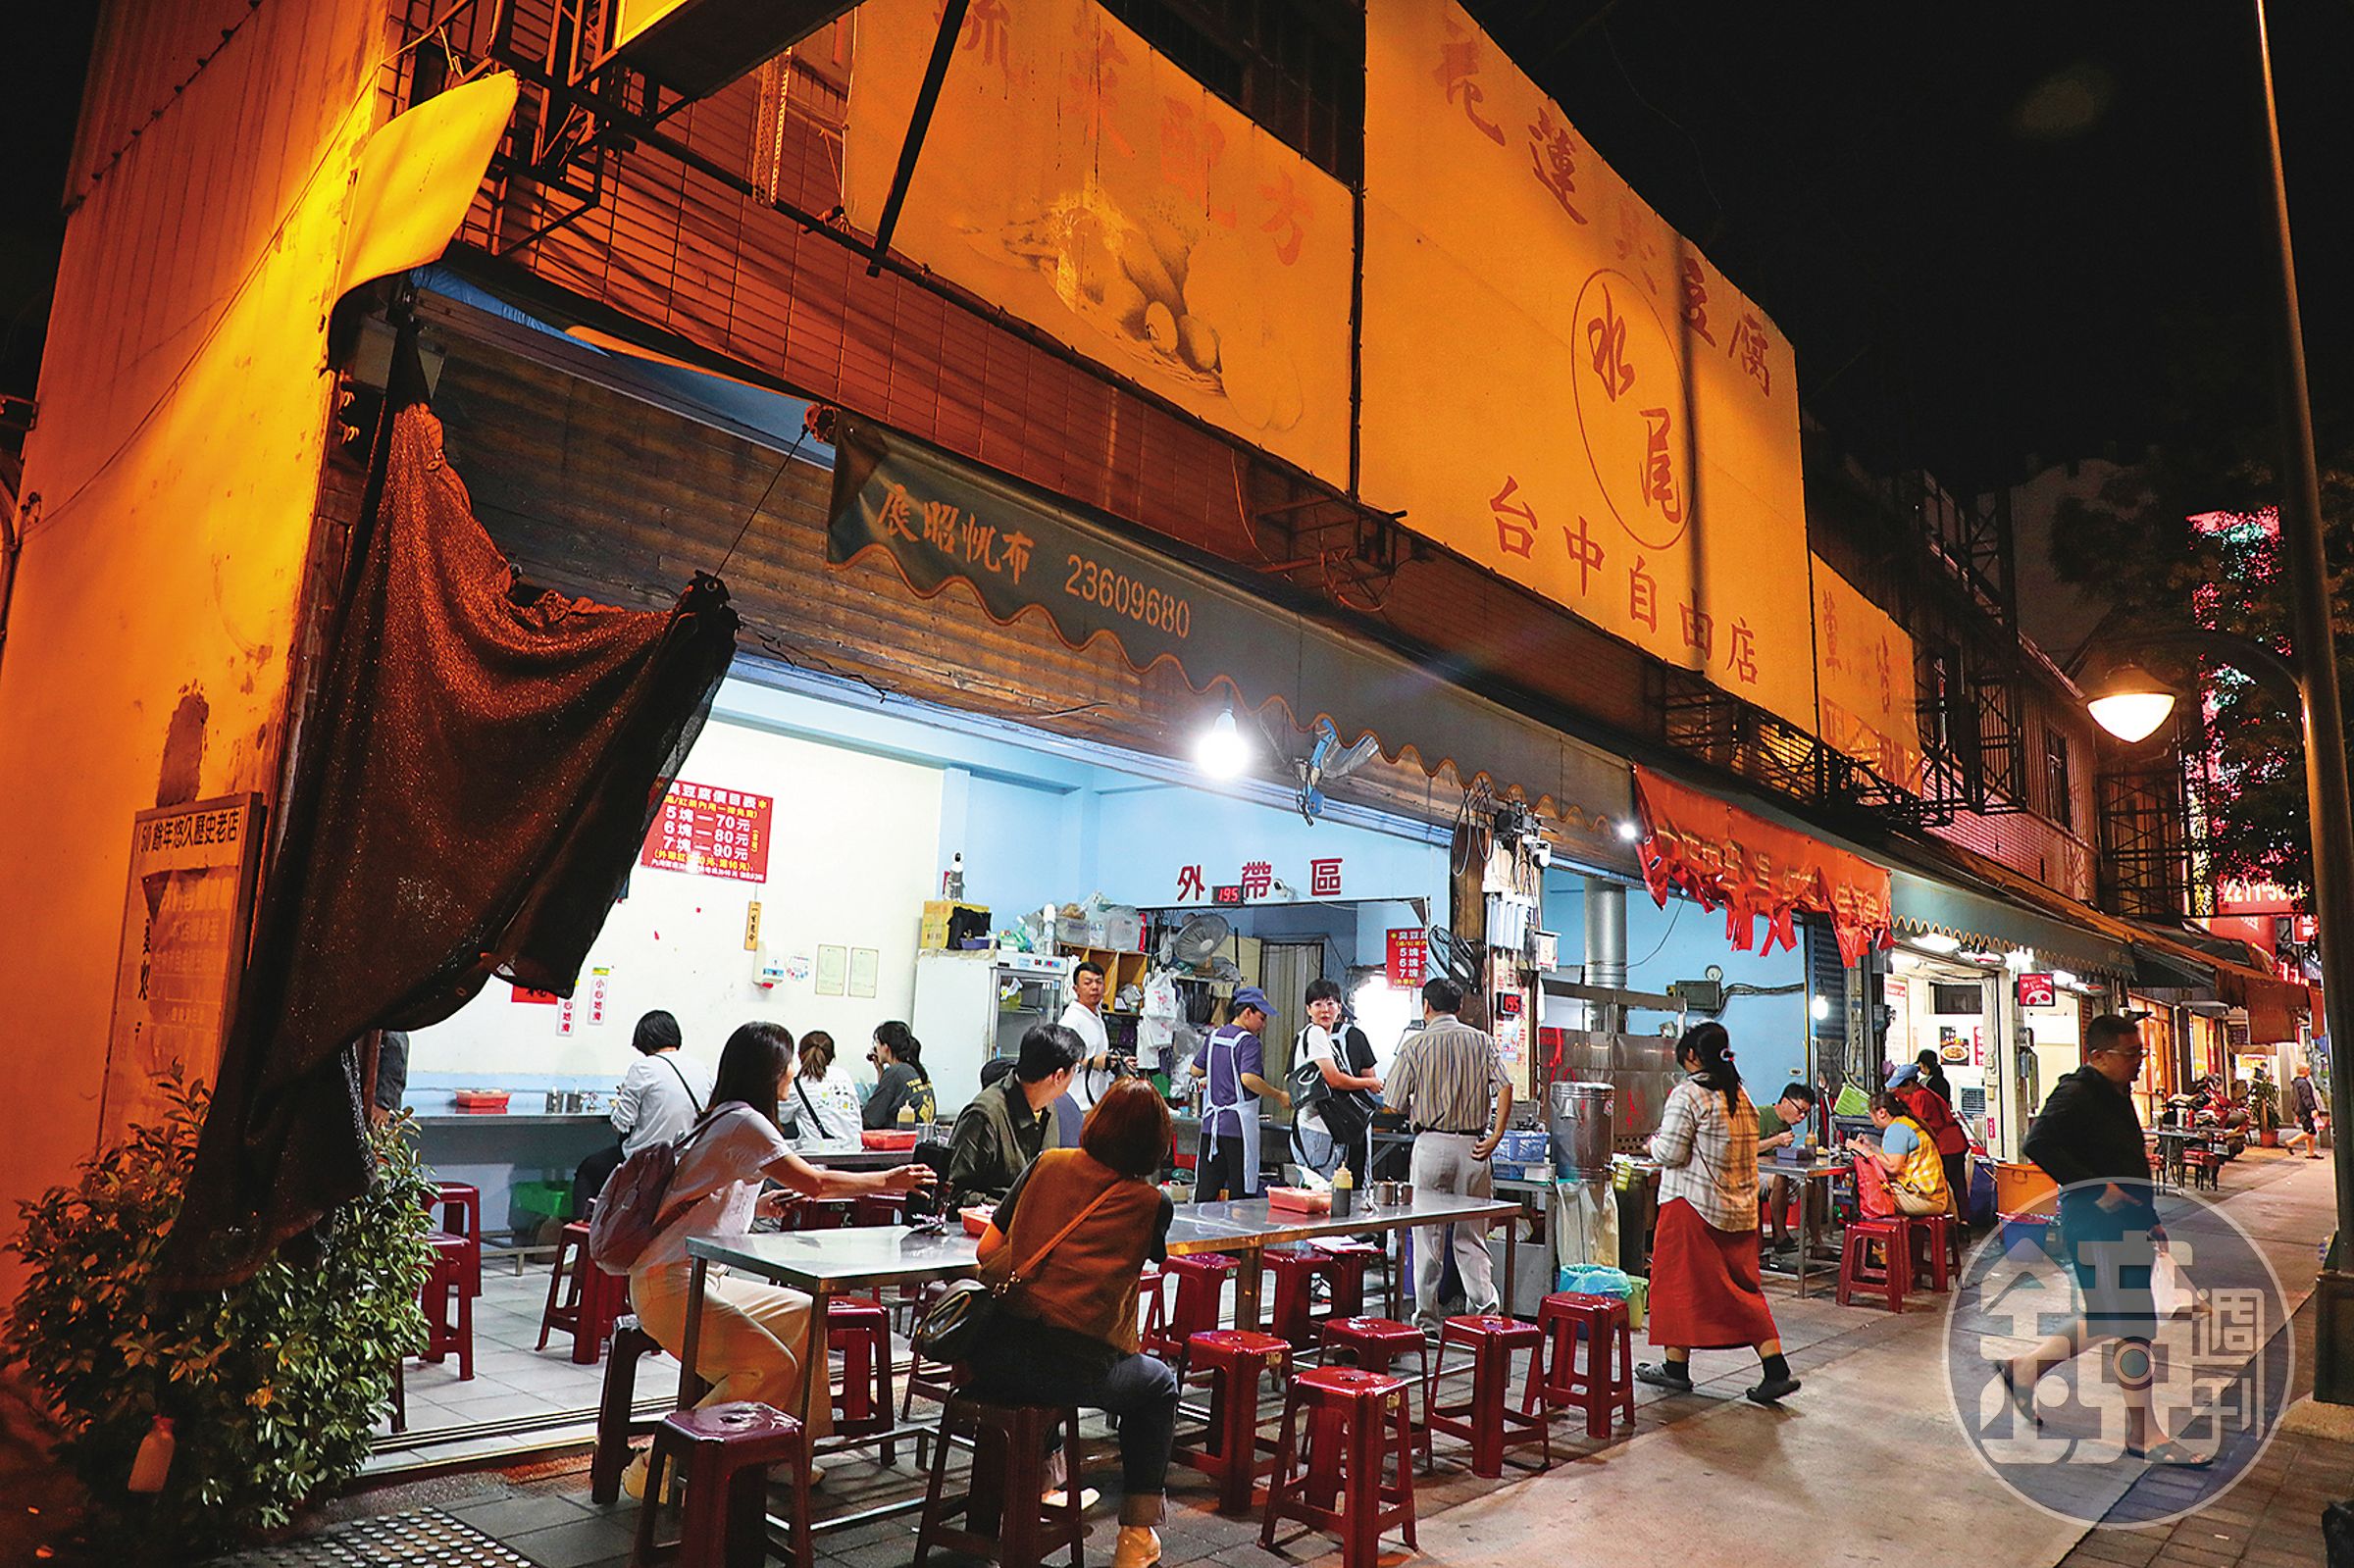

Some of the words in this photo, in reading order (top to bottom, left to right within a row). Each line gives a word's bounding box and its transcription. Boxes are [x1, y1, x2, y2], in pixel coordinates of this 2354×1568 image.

[1065, 553, 1191, 639] 23609680
[1489, 475, 1759, 686] 台中自由店
[1177, 858, 1344, 902] 外帶區
[1218, 887, 1240, 902] 195
